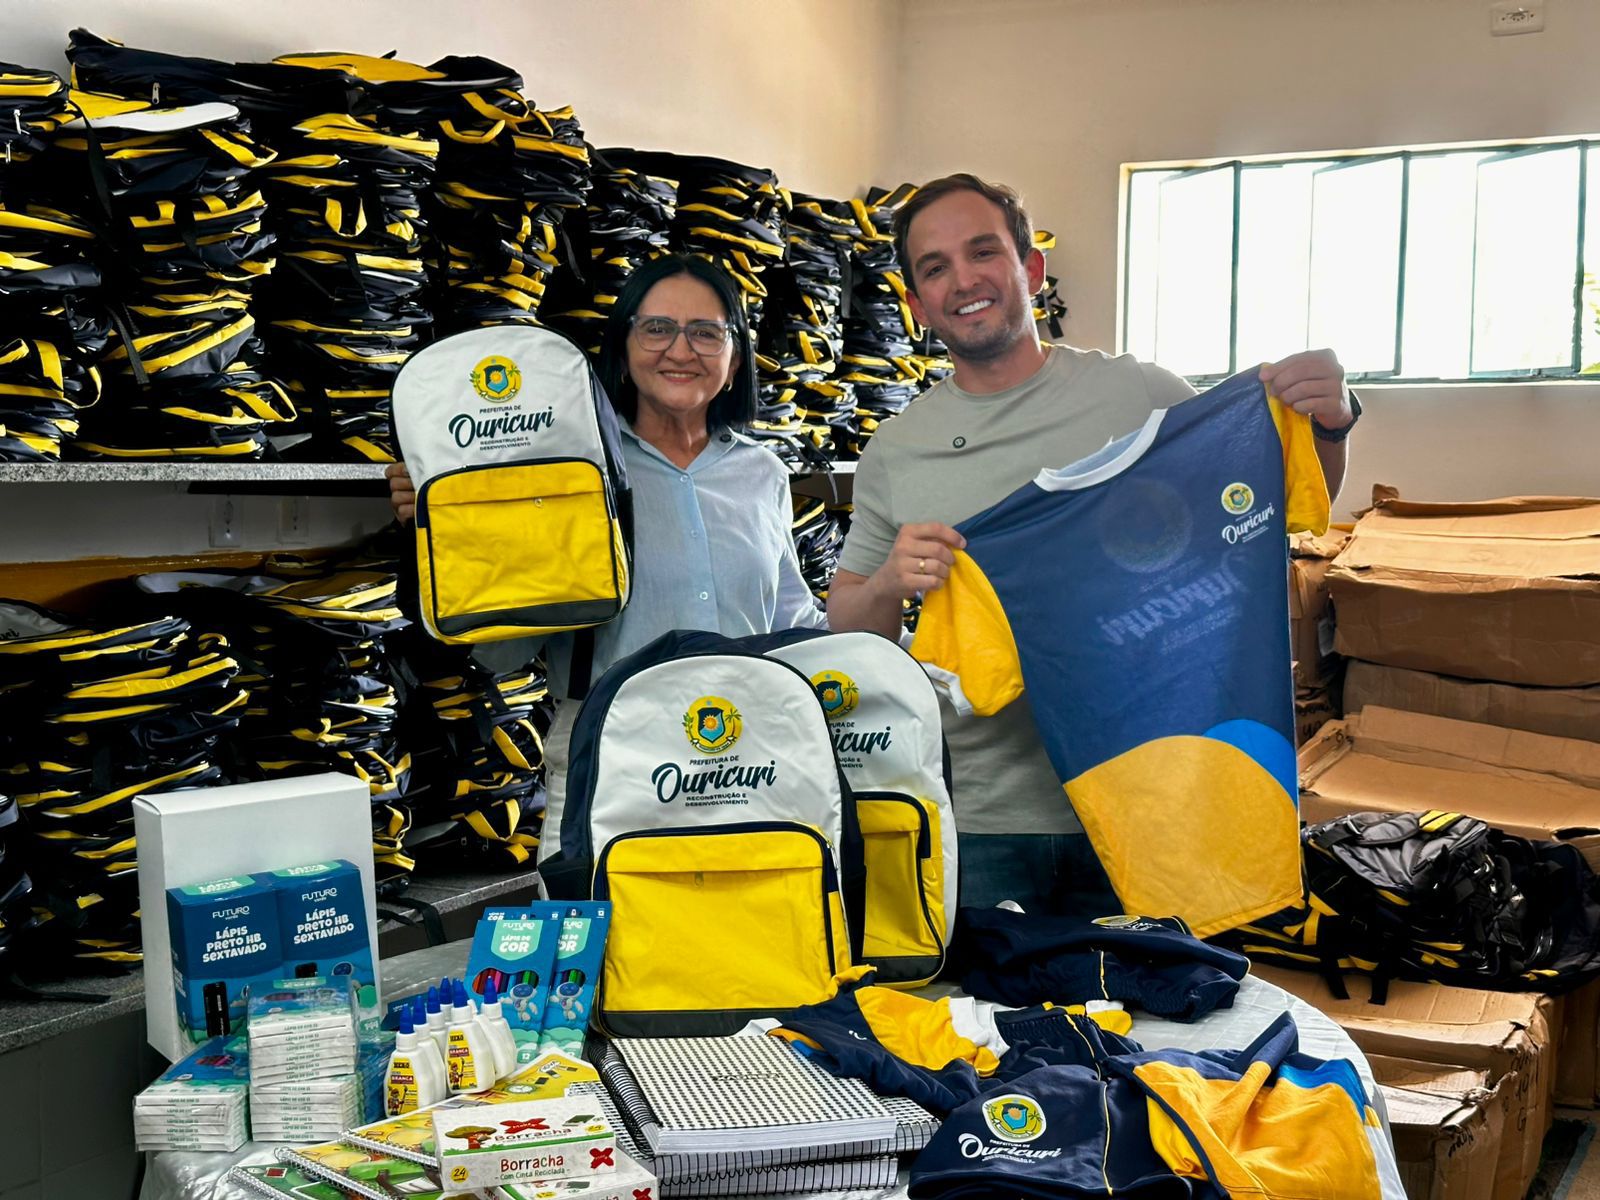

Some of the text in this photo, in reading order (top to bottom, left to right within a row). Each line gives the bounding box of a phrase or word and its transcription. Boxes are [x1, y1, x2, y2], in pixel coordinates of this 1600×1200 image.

[480, 406, 512, 414] PREFEITURA
[448, 406, 555, 448] Ouricuri
[480, 442, 531, 450] DESENVOLVIMENTO
[1222, 502, 1275, 544] Ouricuri
[833, 726, 892, 754] icuri
[690, 756, 728, 766] PREFEITURA
[652, 760, 777, 803] Ouricuri
[686, 792, 741, 801] RECONSTRUÇÃO
[302, 888, 338, 902] FUTURO
[212, 905, 250, 918] FUTURO
[306, 907, 336, 922] LÁPIS
[335, 914, 349, 925] HB
[216, 922, 248, 940] LÁPIS
[246, 933, 261, 943] HB
[499, 942, 529, 952] COR
[559, 941, 577, 952] OR
[494, 1128, 572, 1141] Borracha
[958, 1133, 1062, 1159] Ouricuri
[501, 1154, 564, 1172] Borracha
[454, 1168, 466, 1176] 24
[535, 1168, 565, 1177] Reciclada
